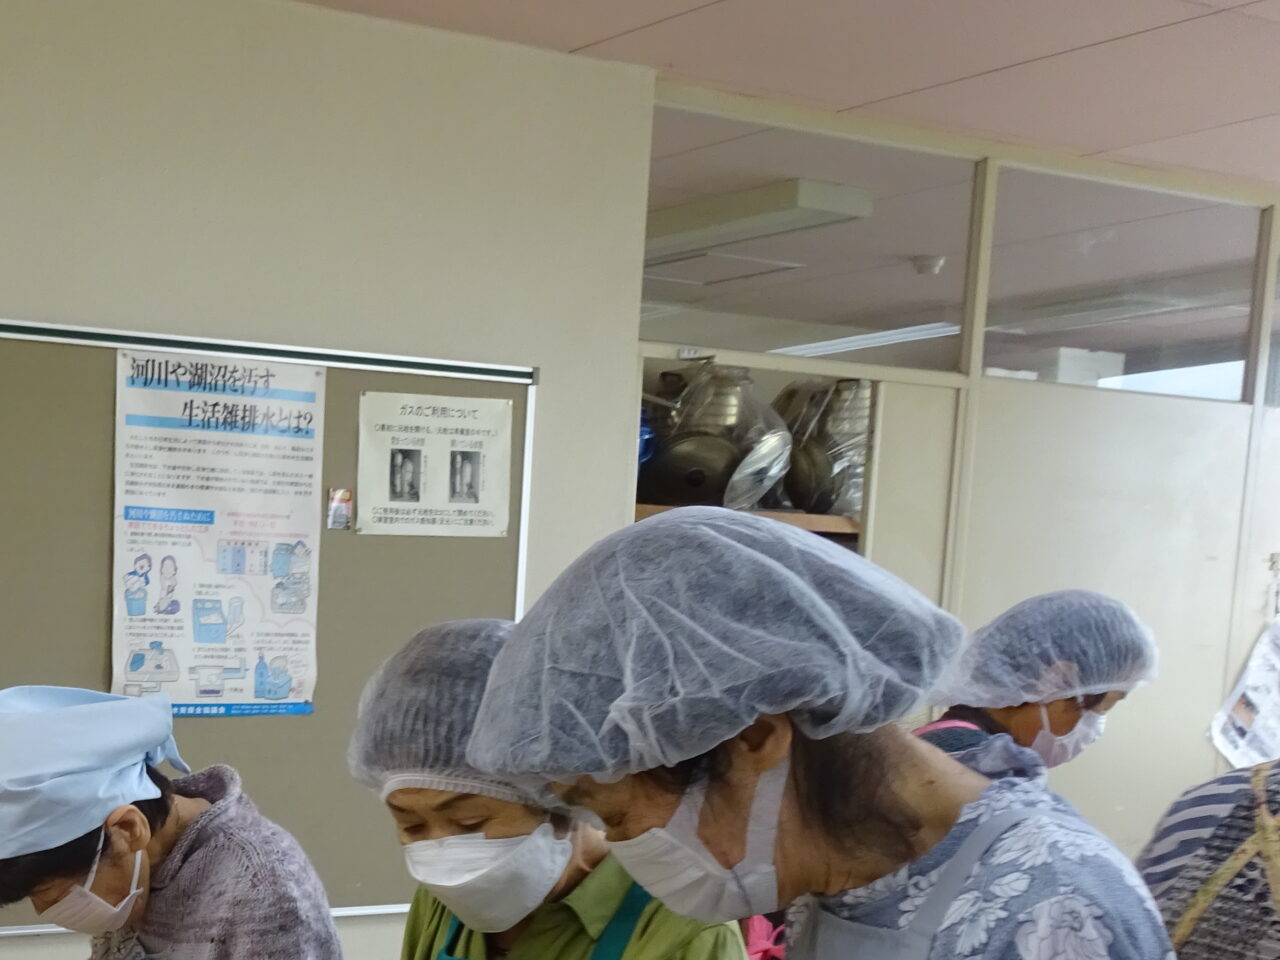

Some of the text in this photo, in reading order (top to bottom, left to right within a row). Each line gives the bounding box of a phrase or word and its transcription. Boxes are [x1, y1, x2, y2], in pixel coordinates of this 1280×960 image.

[131, 356, 277, 397] 河川や湖沼を汚す
[399, 404, 478, 420] ガスのご利用について
